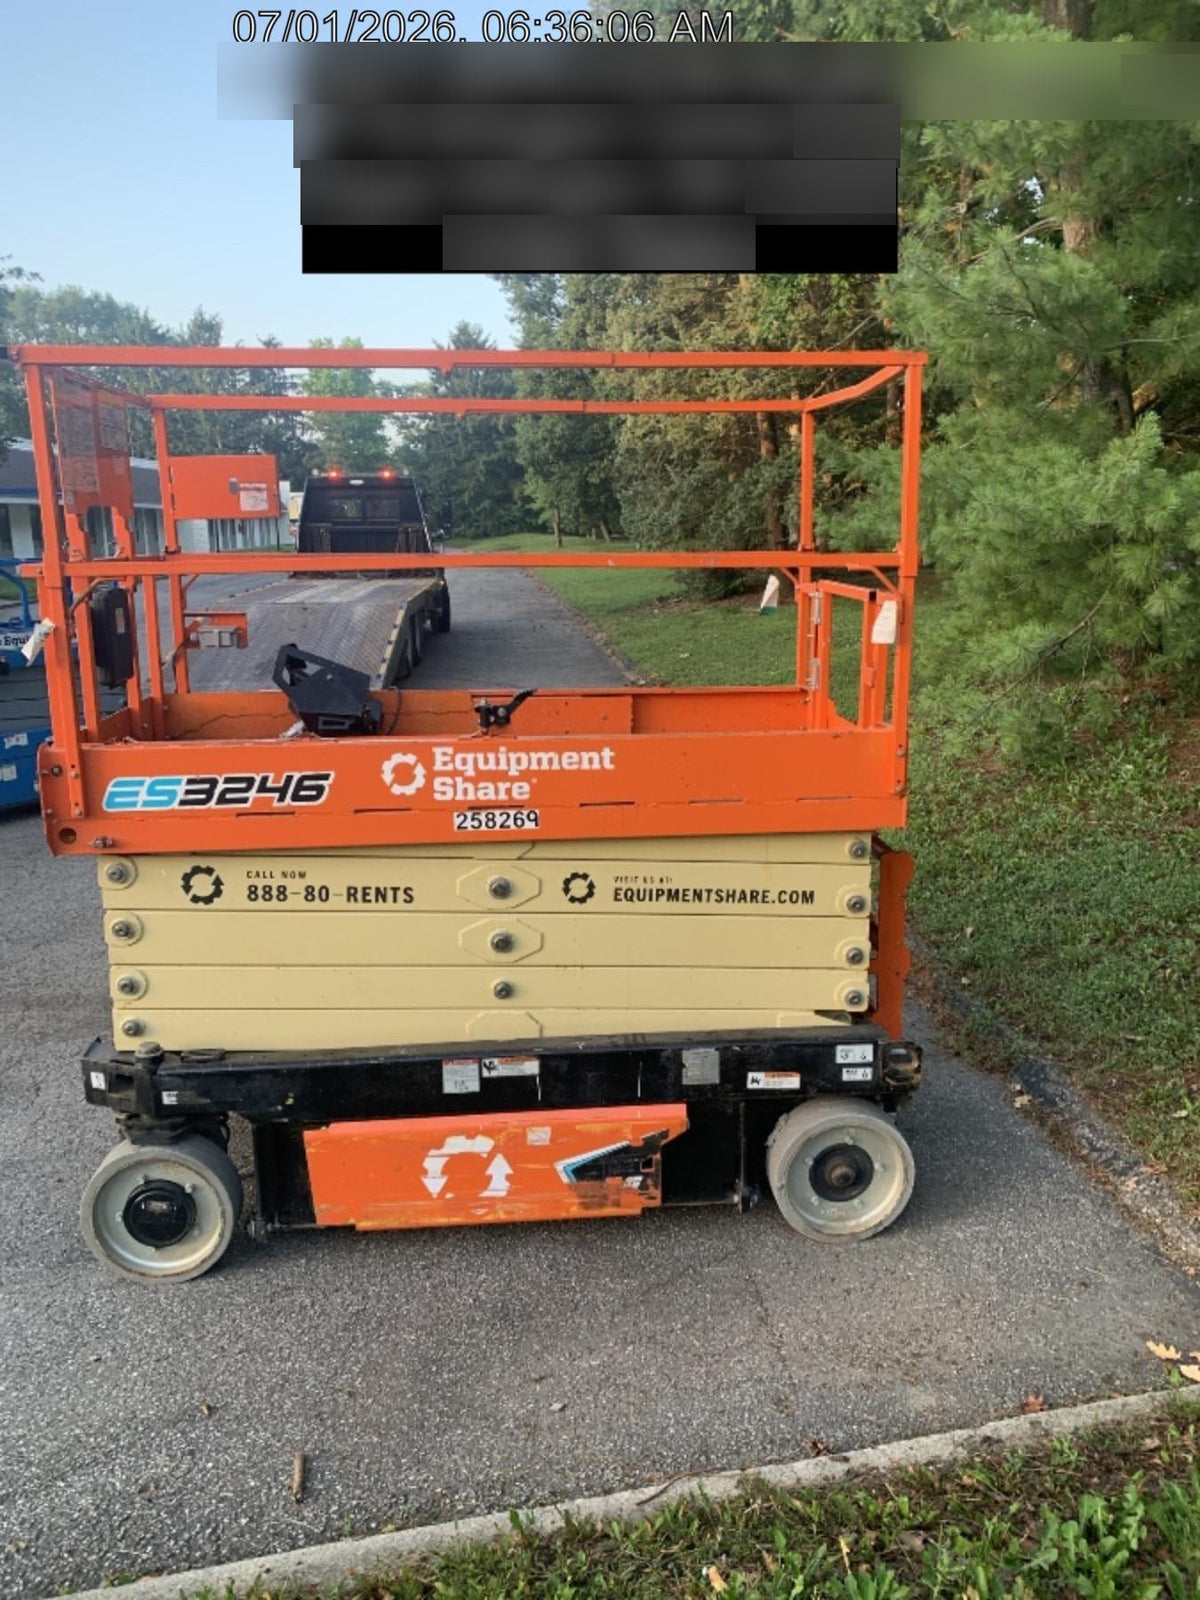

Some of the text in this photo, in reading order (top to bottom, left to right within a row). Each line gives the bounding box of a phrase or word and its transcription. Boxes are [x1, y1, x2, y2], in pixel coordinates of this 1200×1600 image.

[432, 746, 615, 776] Equipment
[103, 772, 333, 811] ES3246
[432, 776, 531, 801] Share
[456, 810, 539, 830] 258269
[246, 870, 307, 879] CALL NOW
[246, 884, 415, 904] 888-80-RENTS
[613, 886, 815, 905] EQUIPMENTSHARE.COM
